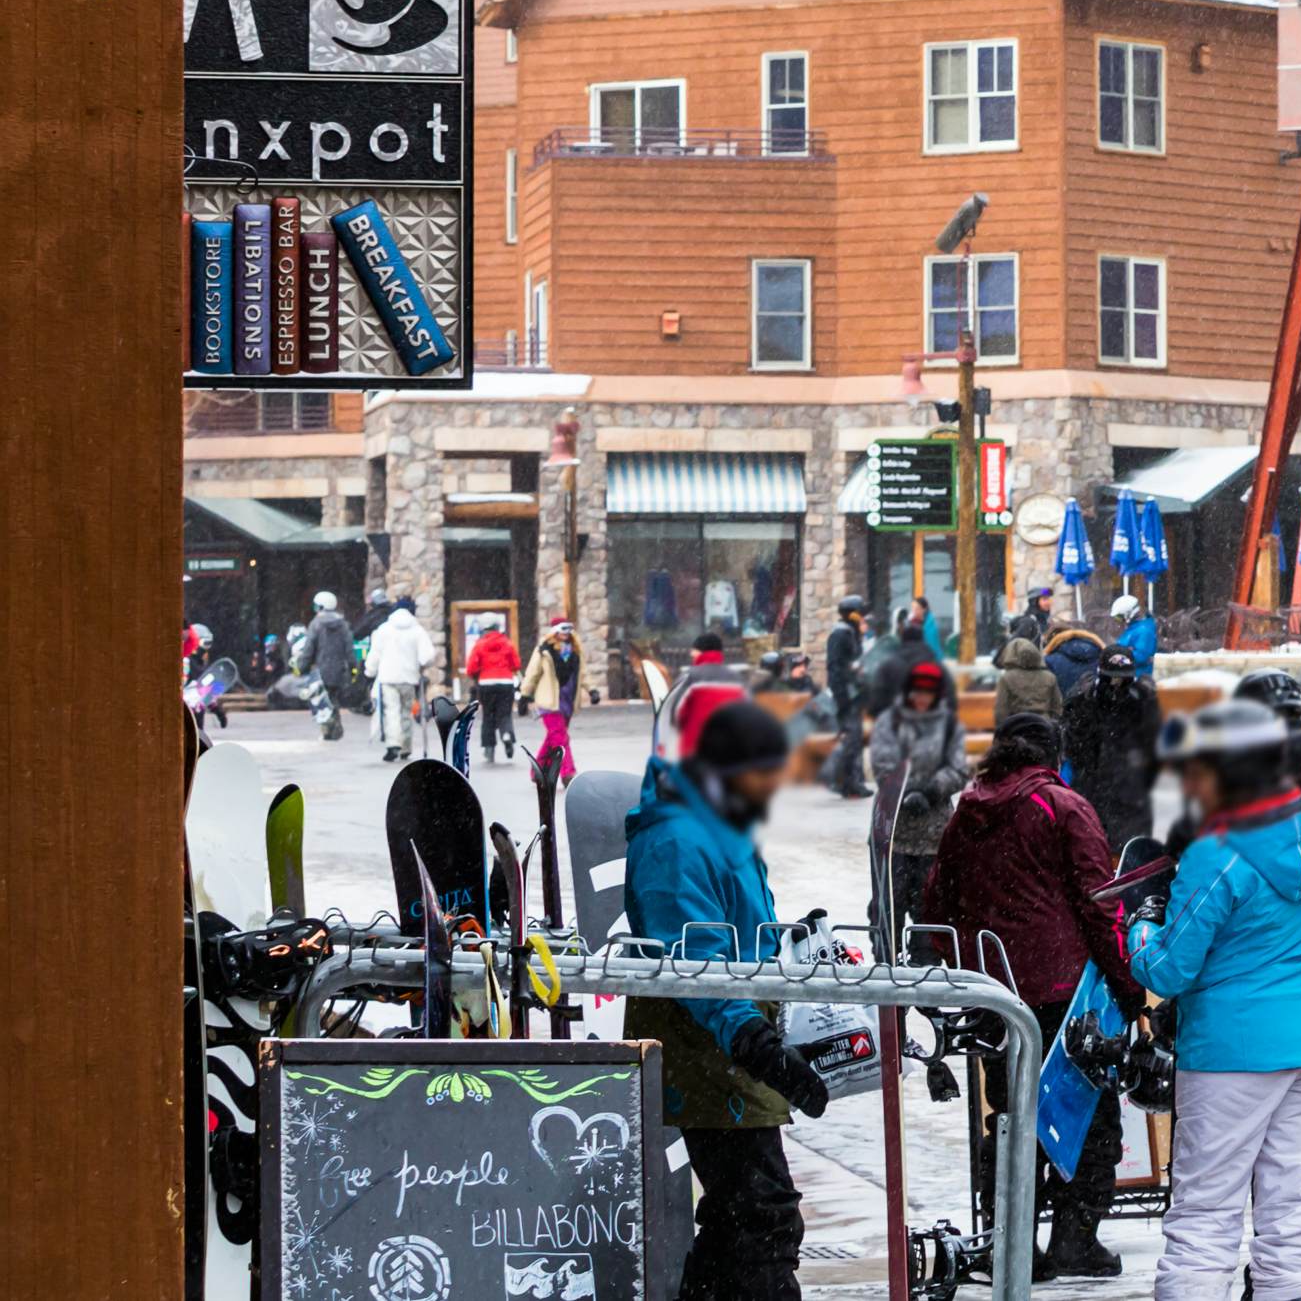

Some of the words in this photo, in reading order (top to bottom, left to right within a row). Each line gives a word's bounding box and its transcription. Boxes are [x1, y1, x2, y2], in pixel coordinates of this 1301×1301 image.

[278, 205, 295, 247] BAR
[205, 236, 221, 364] BOOKSTORE
[244, 220, 262, 360] LIBATIONS
[278, 255, 295, 365] ESPRESSO
[308, 248, 331, 360] LUNCH
[347, 214, 438, 361] BREAKFAST
[393, 1150, 517, 1217] people
[472, 1200, 638, 1248] BILLABONG
